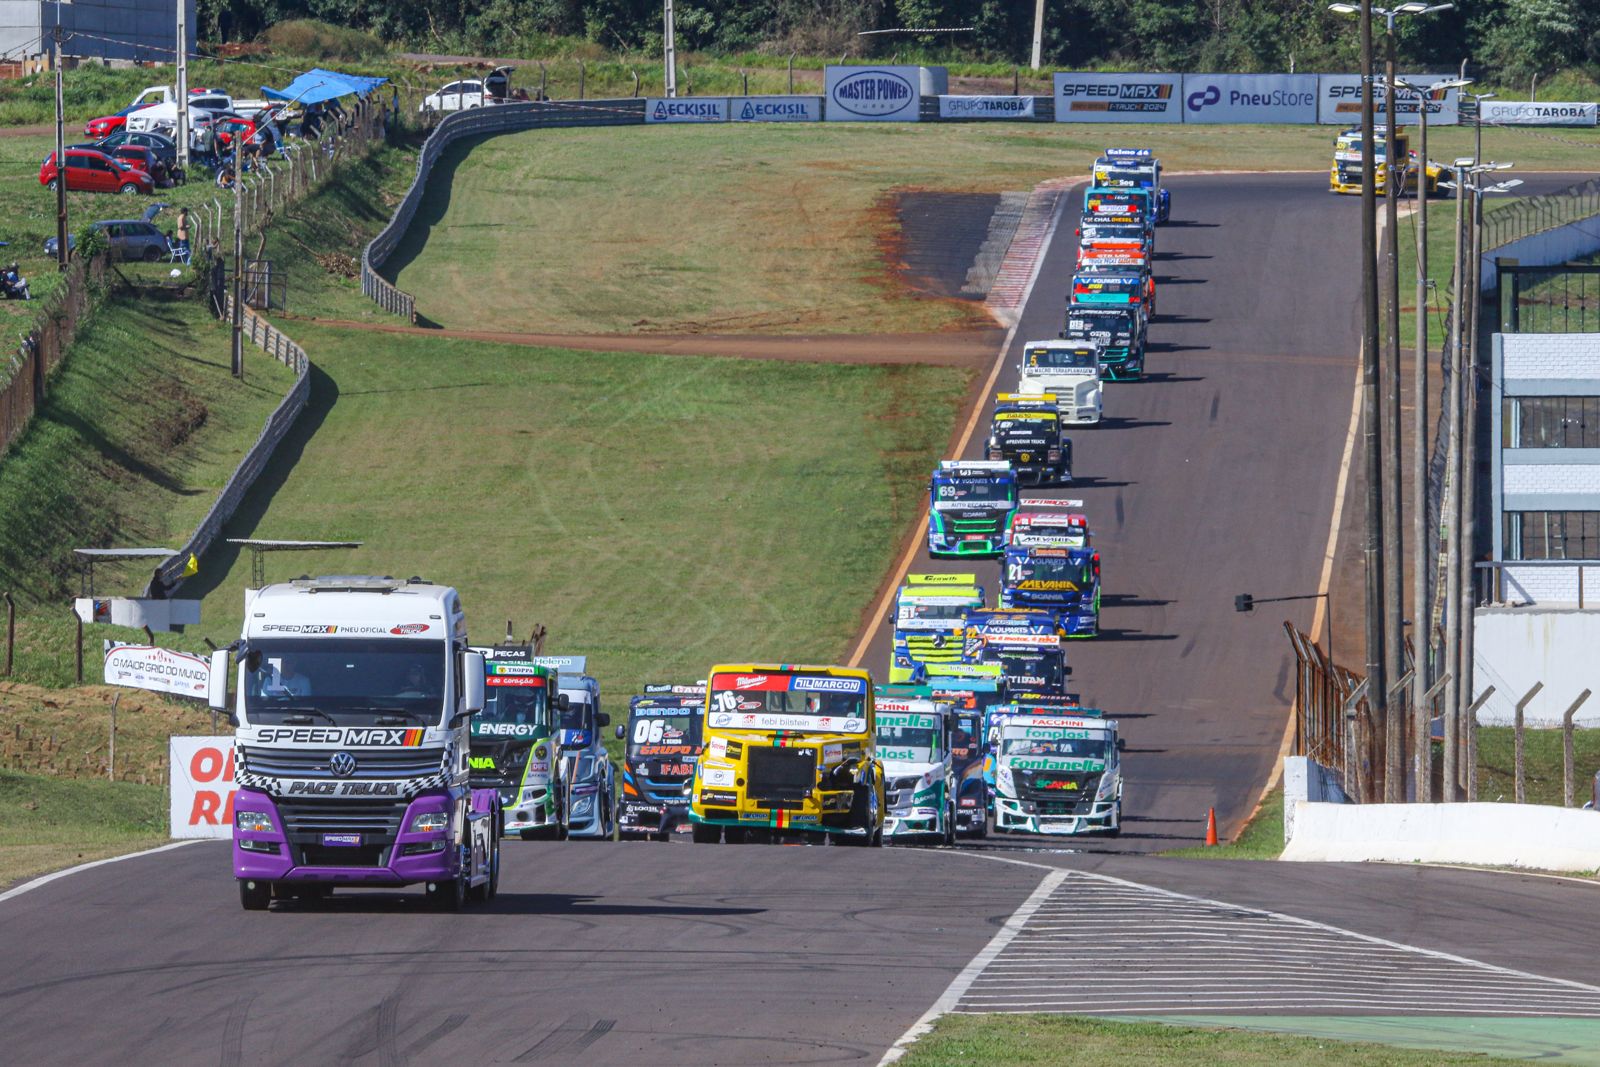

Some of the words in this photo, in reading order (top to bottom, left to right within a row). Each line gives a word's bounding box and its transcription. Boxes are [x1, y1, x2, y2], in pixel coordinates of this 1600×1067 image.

[838, 78, 876, 100] MASTER
[877, 78, 908, 100] POWER
[1230, 90, 1314, 106] PneuStore
[668, 104, 720, 115] ECKISIL
[755, 104, 808, 115] ECKISIL
[940, 486, 956, 496] 69
[1008, 564, 1022, 580] 21
[1017, 580, 1078, 591] MEVANIA
[534, 658, 572, 666] Helena
[166, 666, 178, 676] DO
[178, 668, 206, 681] MUNDO
[268, 658, 282, 691] 1
[814, 680, 858, 690] MARCON
[714, 690, 736, 712] 76
[761, 717, 778, 725] febi
[780, 718, 810, 726] bilstein
[478, 724, 538, 735] ENERGY
[634, 720, 664, 744] 06
[1026, 728, 1090, 740] fonplast
[640, 746, 692, 755] GRUPO
[468, 758, 496, 769] NIA
[1010, 758, 1105, 771] Fontanella
[288, 782, 338, 795] PACE
[342, 782, 401, 795] TRUCK
[1036, 780, 1078, 790] SCANIA
